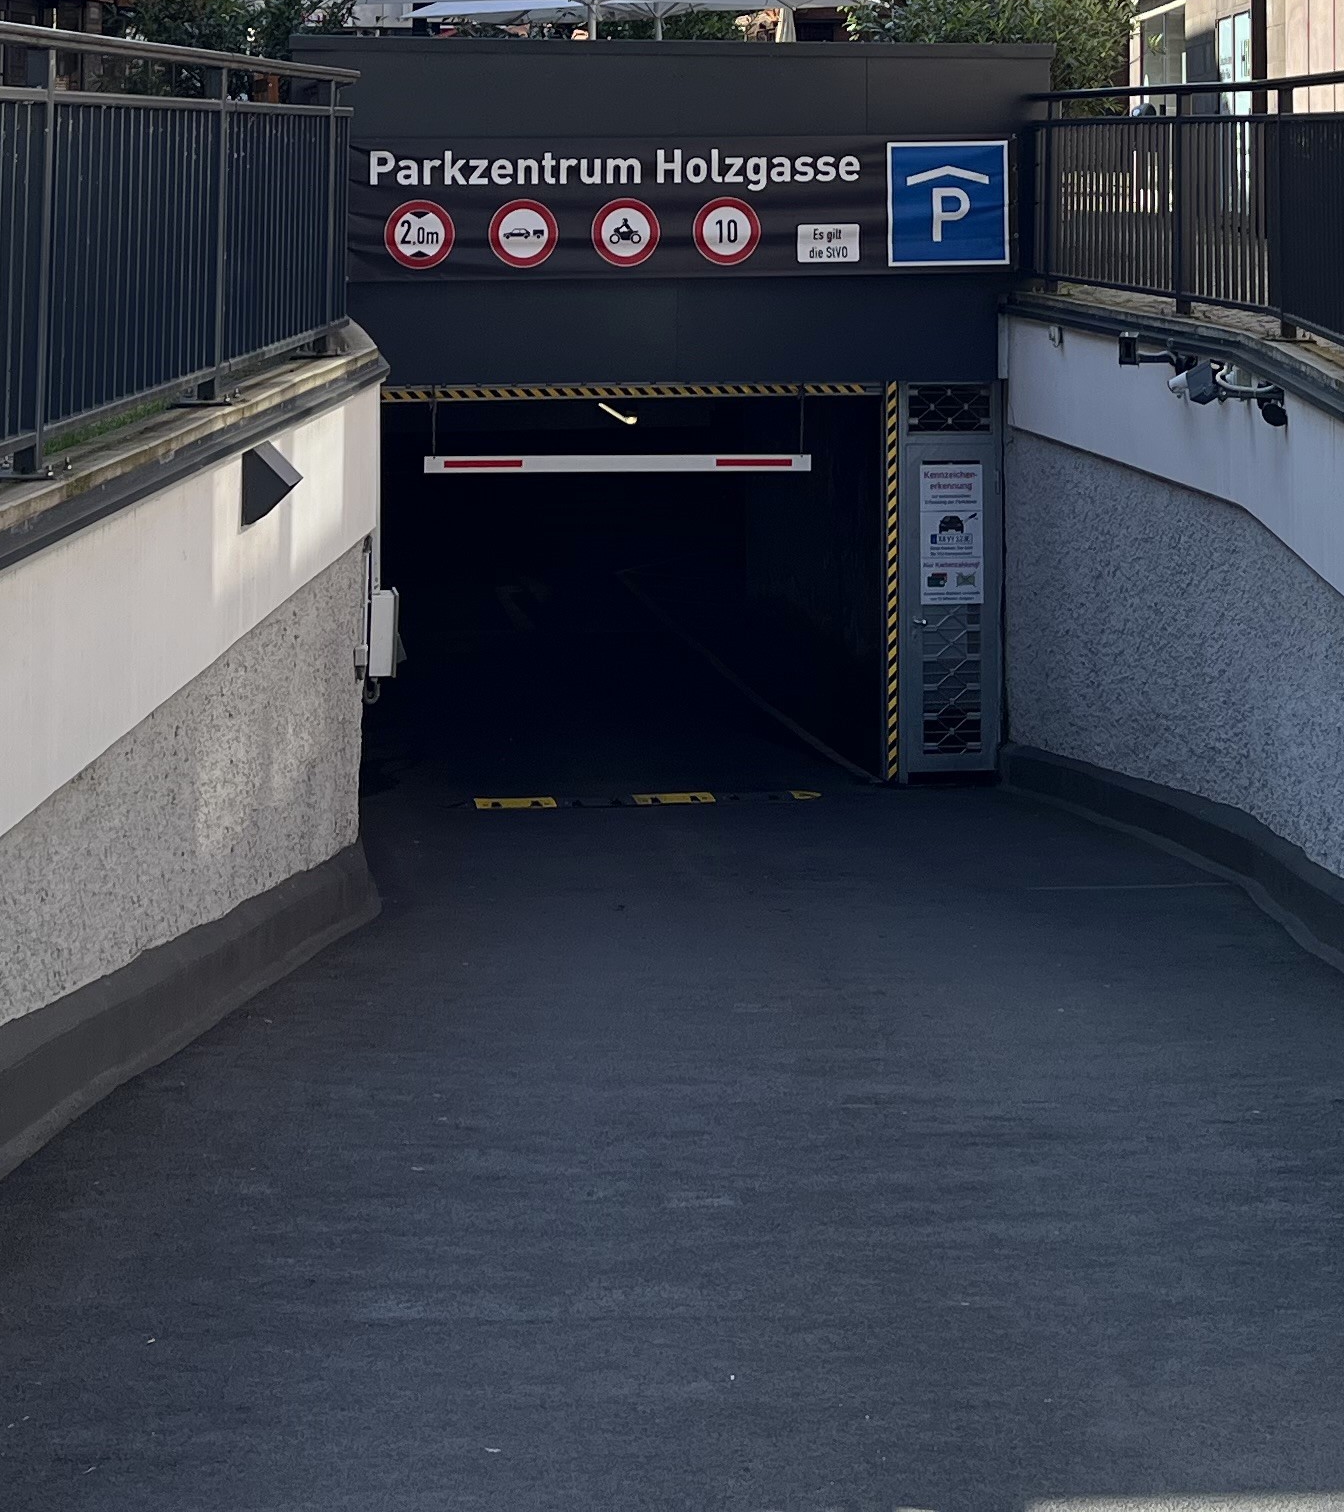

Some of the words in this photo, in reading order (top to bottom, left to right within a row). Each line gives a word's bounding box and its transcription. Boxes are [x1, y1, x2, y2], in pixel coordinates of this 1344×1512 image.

[369, 149, 642, 186] Parkzentrum
[655, 147, 861, 192] Holzgasse
[932, 186, 971, 243] P
[714, 219, 739, 244] 10
[812, 228, 825, 241] Es
[826, 228, 842, 243] gilt
[809, 245, 824, 259] die
[825, 245, 848, 259] StVO
[923, 470, 978, 480] Kennzeichen-
[929, 481, 973, 491] erkennung
